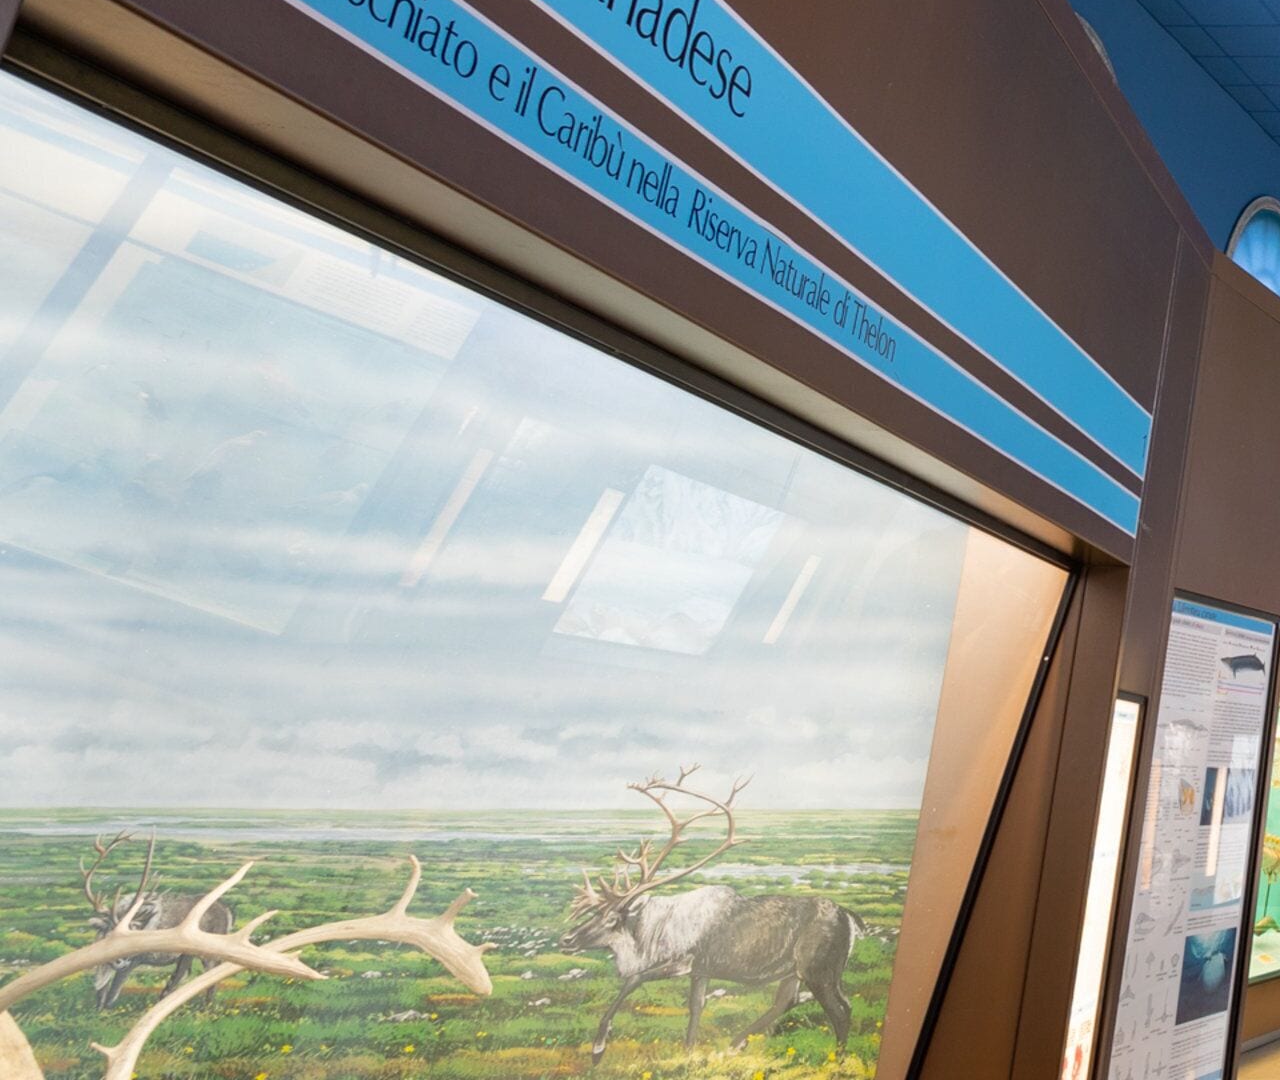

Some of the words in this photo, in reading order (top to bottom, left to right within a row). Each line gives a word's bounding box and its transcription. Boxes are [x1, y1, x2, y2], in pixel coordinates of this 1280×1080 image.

[488, 63, 510, 102] e
[514, 66, 537, 117] il
[537, 85, 625, 181] Caribù
[626, 158, 680, 218] nella
[687, 189, 757, 269] Riserva
[760, 238, 831, 316] Naturale
[833, 290, 851, 329] di
[852, 299, 897, 363] Thelon
